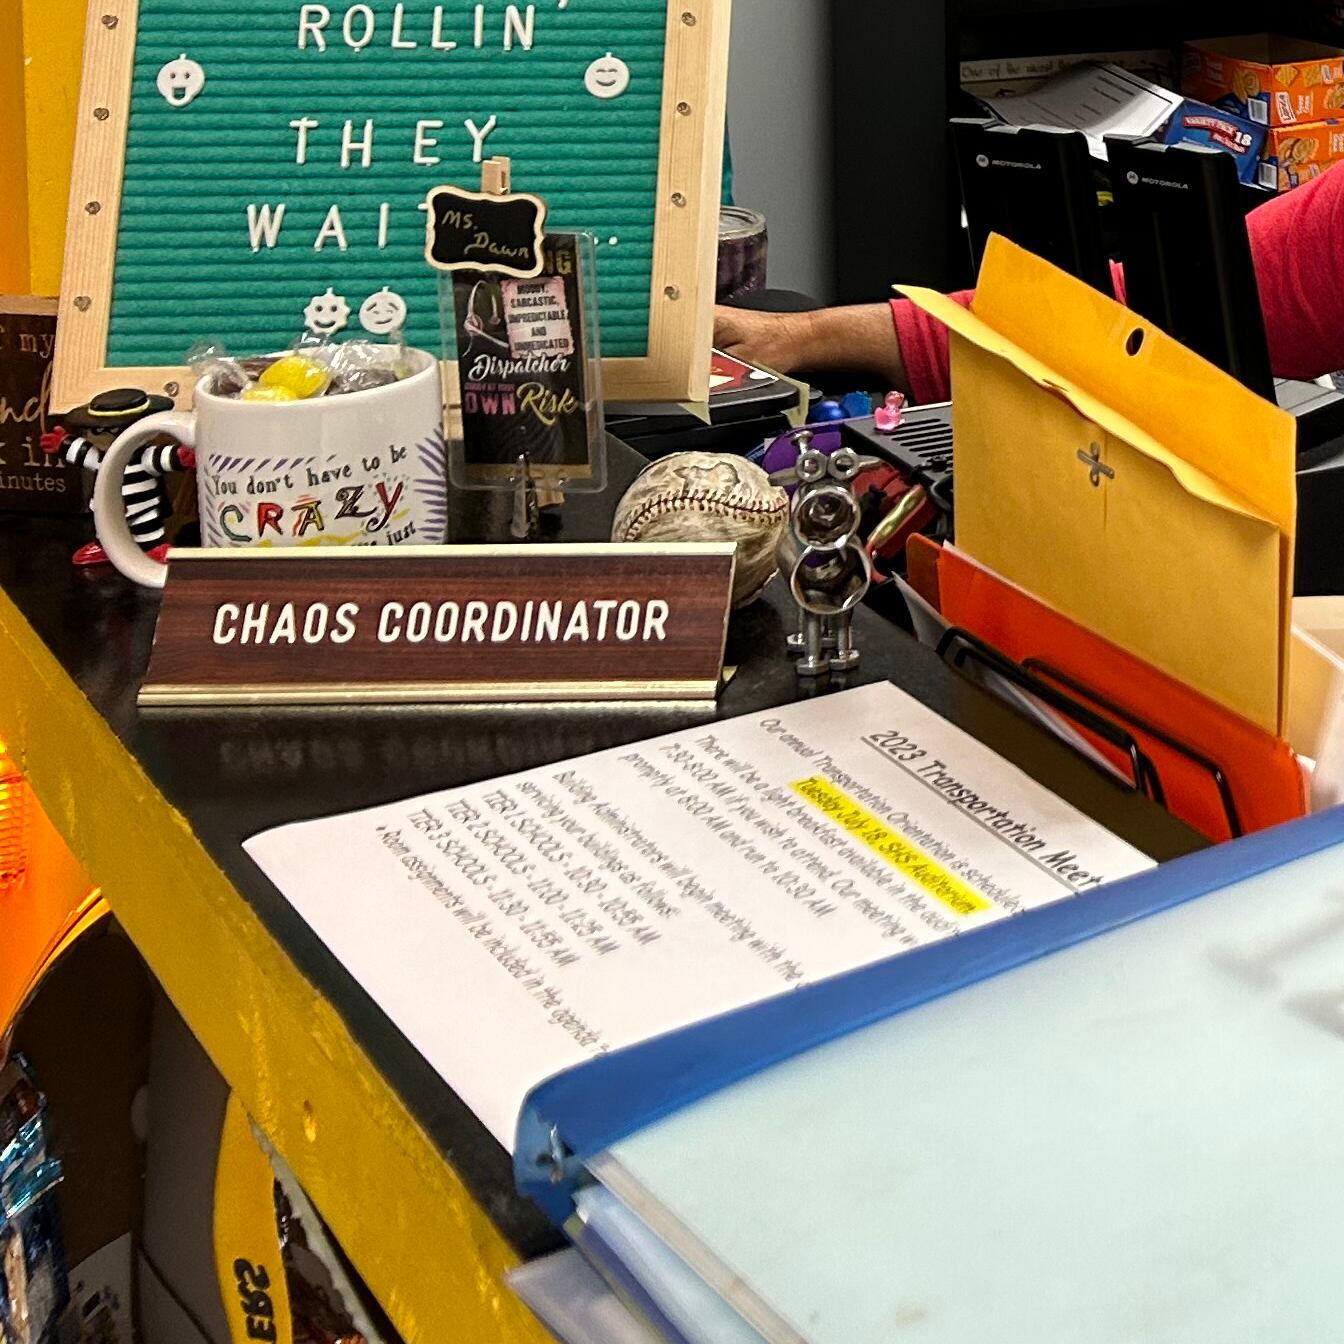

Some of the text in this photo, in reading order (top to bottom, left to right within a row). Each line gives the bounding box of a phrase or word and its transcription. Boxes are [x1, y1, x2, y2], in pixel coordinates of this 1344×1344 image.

[290, 115, 497, 168] THEY
[247, 204, 432, 253] WAI
[464, 232, 530, 259] Dawn
[467, 353, 571, 381] Dispatcher
[210, 444, 408, 495] You don't have to be
[218, 480, 403, 543] CRAZY
[212, 599, 670, 646] CHAOS COORDINATOR
[868, 729, 1104, 887] 2023 Transportation Meet
